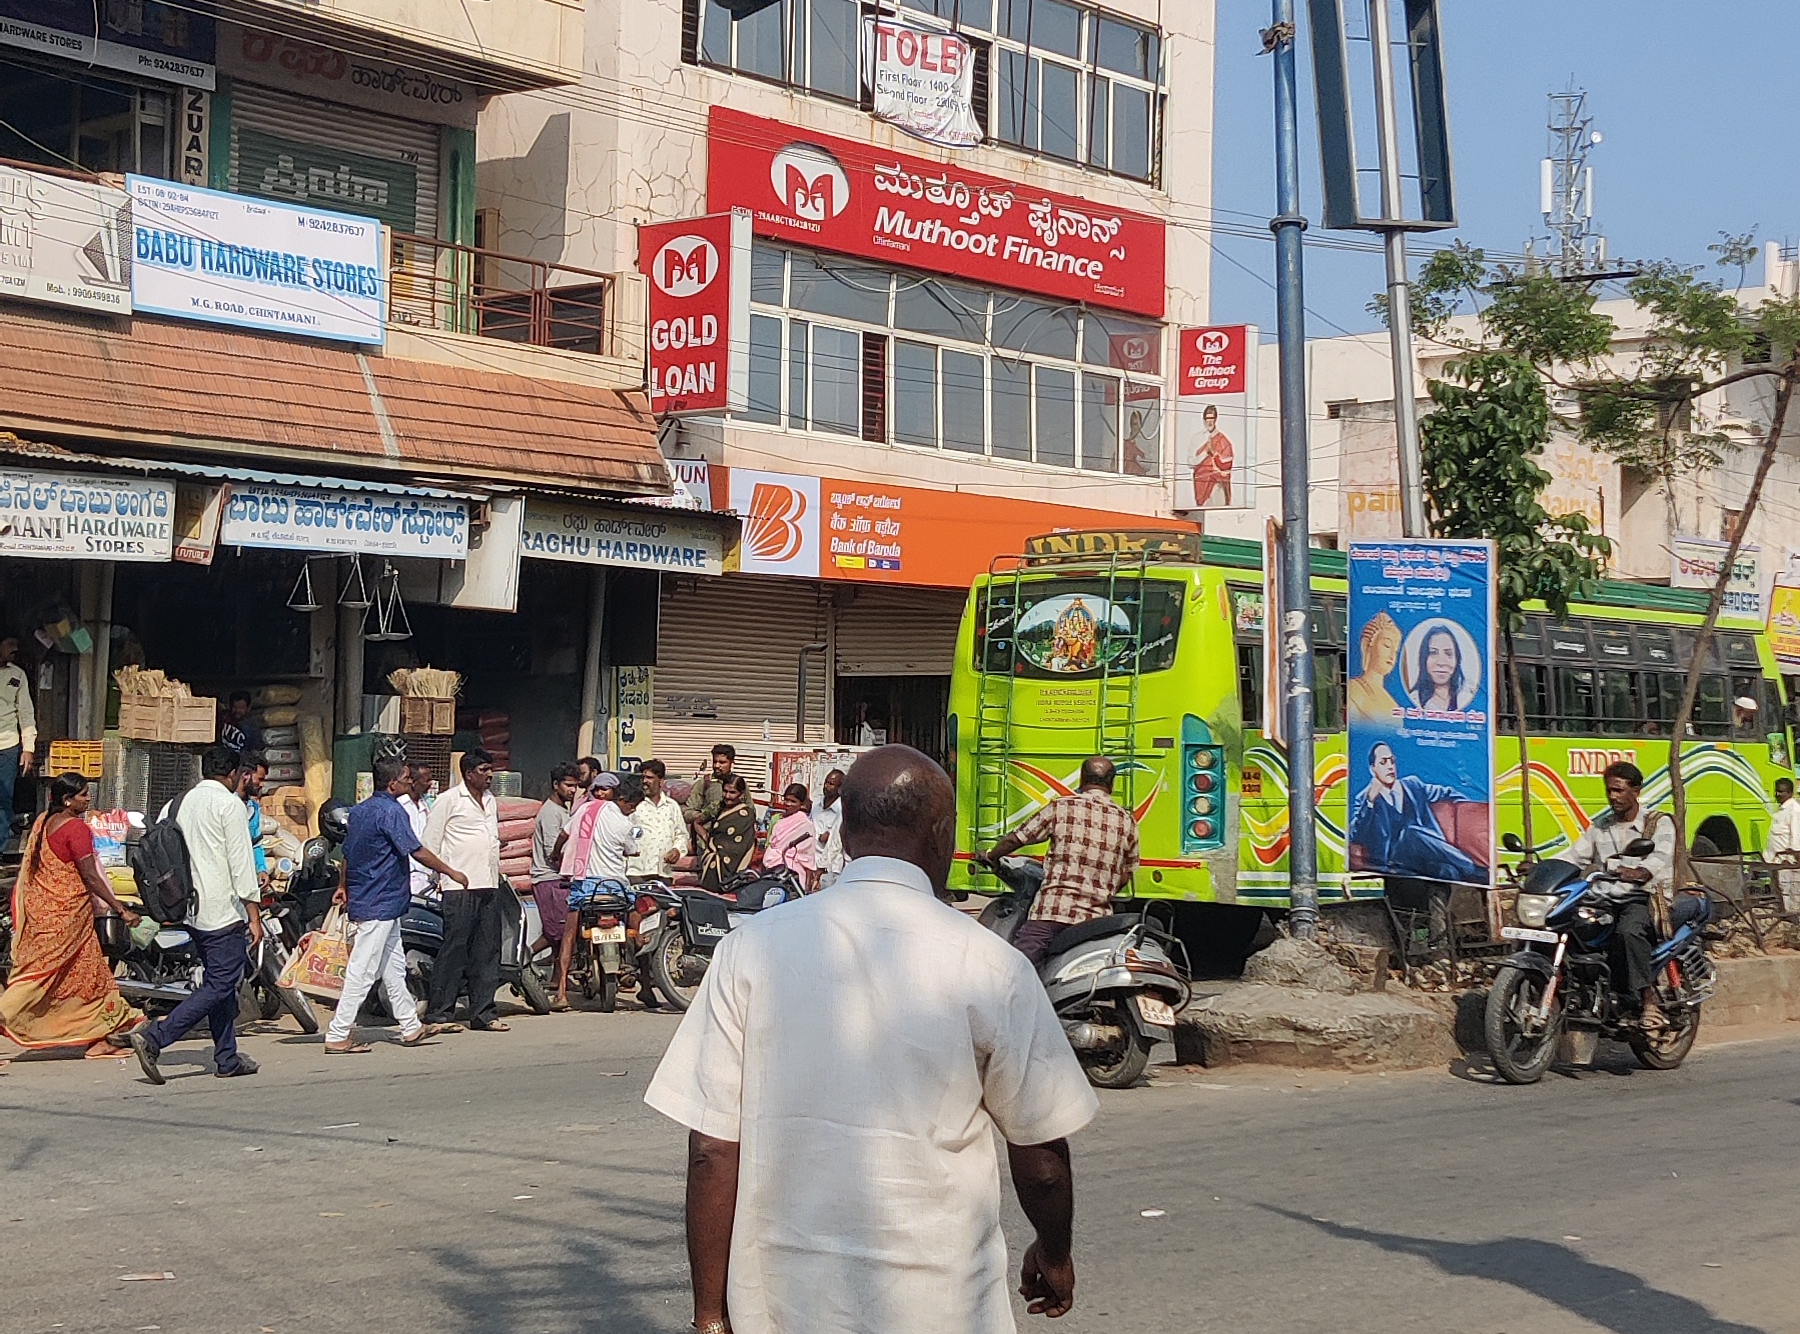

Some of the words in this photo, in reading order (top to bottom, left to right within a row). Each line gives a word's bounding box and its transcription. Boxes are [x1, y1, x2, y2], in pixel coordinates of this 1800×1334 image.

[49, 34, 83, 52] STORES
[874, 162, 1015, 225] ಮುತ್ತೂಟ್
[1028, 198, 1126, 261] ಫೈನಾನ್ಸ್
[873, 207, 999, 257] Muthoot
[1003, 235, 1104, 280] Finance
[135, 227, 193, 268] BABU
[200, 240, 308, 287] HARDWARE
[311, 257, 378, 297] STORES
[652, 315, 719, 351] GOLD
[1187, 365, 1237, 378] Muthoot
[1201, 354, 1223, 365] The
[651, 362, 716, 399] LOAN
[1194, 377, 1230, 390] Group
[60, 488, 113, 515] ಬಾಬು
[115, 490, 168, 518] ಅಂಗಡಿ
[230, 492, 289, 525] ಬಾಬು
[85, 535, 145, 554] STORES
[522, 530, 592, 557] RAGHU
[596, 538, 707, 568] HARDWARE
[830, 536, 857, 554] Bank
[856, 539, 869, 555] of
[867, 540, 901, 557] Baroda
